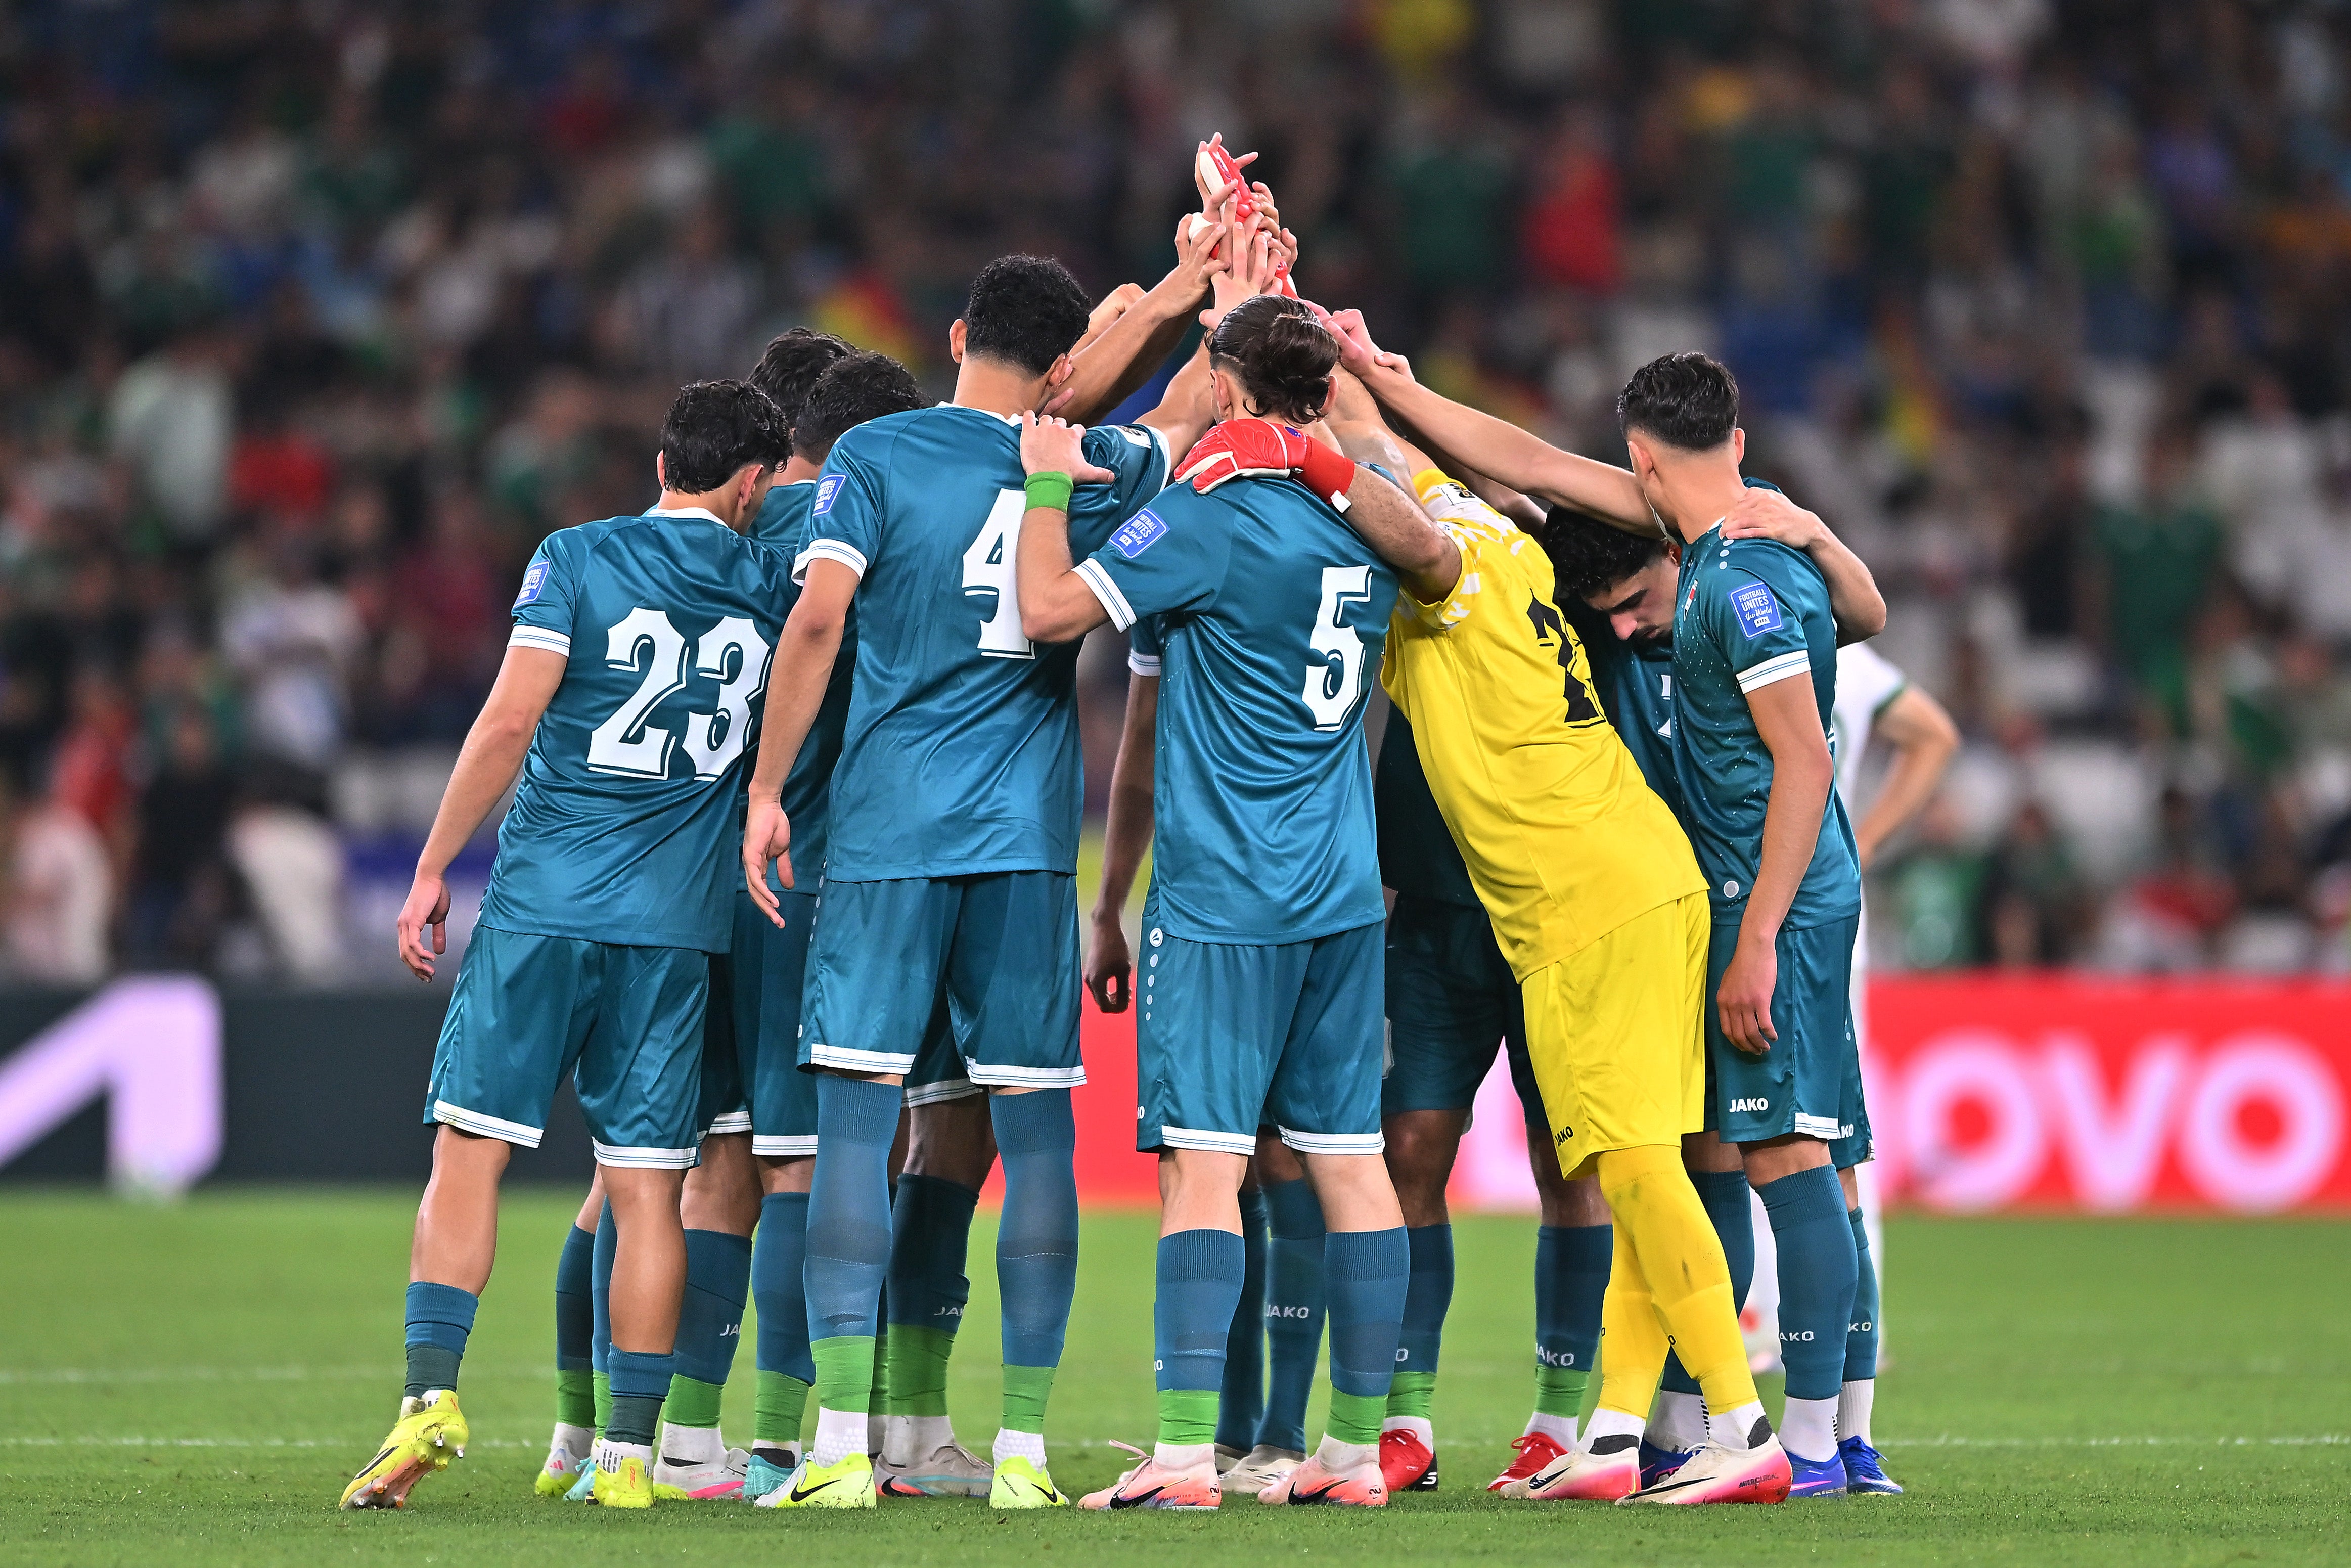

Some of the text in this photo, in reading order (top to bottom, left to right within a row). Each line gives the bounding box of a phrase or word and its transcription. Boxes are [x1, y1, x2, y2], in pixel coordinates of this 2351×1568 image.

[962, 488, 1035, 659] 4
[1738, 588, 1767, 603] FOOTBALL
[1741, 595, 1769, 612] UNITES
[1745, 605, 1773, 621] the World
[1302, 565, 1372, 731] 5
[587, 607, 771, 781] 23
[1729, 1098, 1769, 1113] JAKO
[1555, 1126, 1573, 1147] JAKO
[1779, 1331, 1814, 1341] AKO
